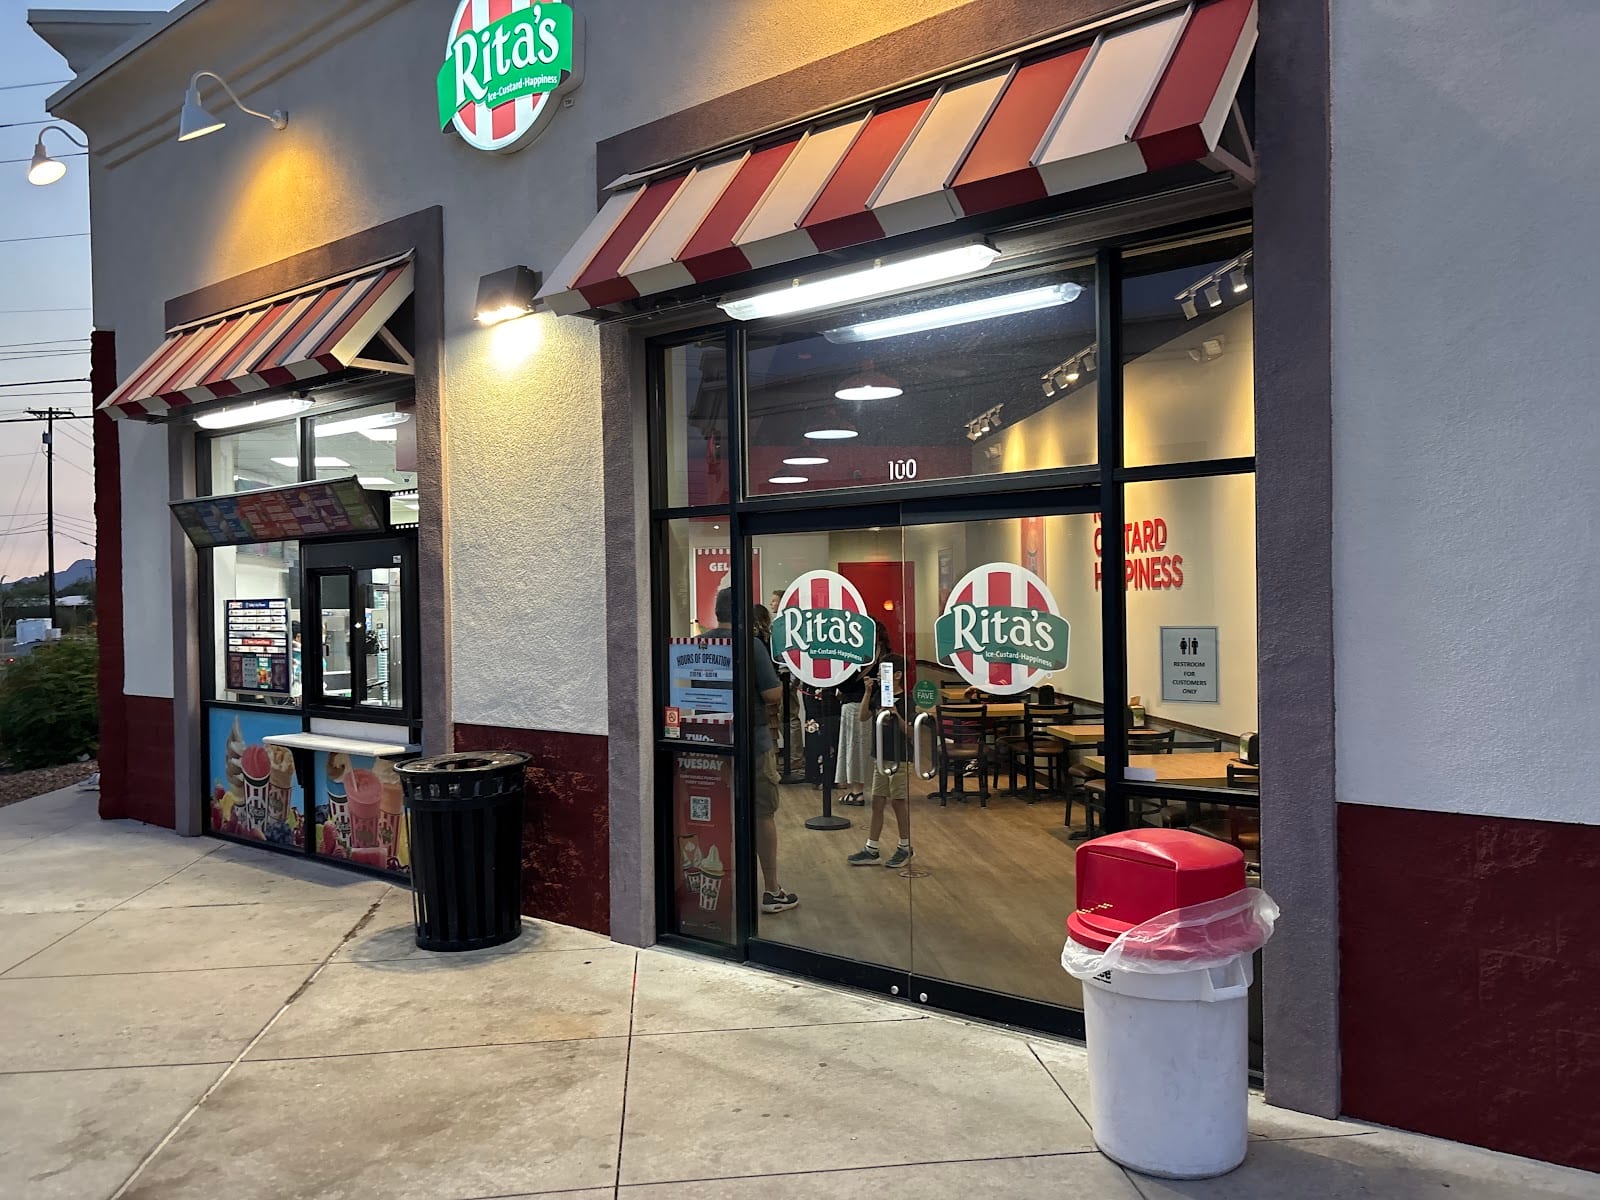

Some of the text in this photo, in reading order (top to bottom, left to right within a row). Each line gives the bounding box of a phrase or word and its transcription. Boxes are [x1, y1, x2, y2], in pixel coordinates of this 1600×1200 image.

[453, 4, 560, 108] Rita's
[888, 458, 917, 480] 100
[1094, 518, 1168, 556] CTARD
[709, 562, 729, 572] GEL
[1093, 555, 1184, 592] HPINESS
[783, 607, 864, 650] Rita's
[953, 604, 1055, 652] Rita's
[677, 653, 731, 668] HOURS OF OPERATION
[917, 691, 935, 700] FAVE
[677, 758, 724, 771] TUESDAY
